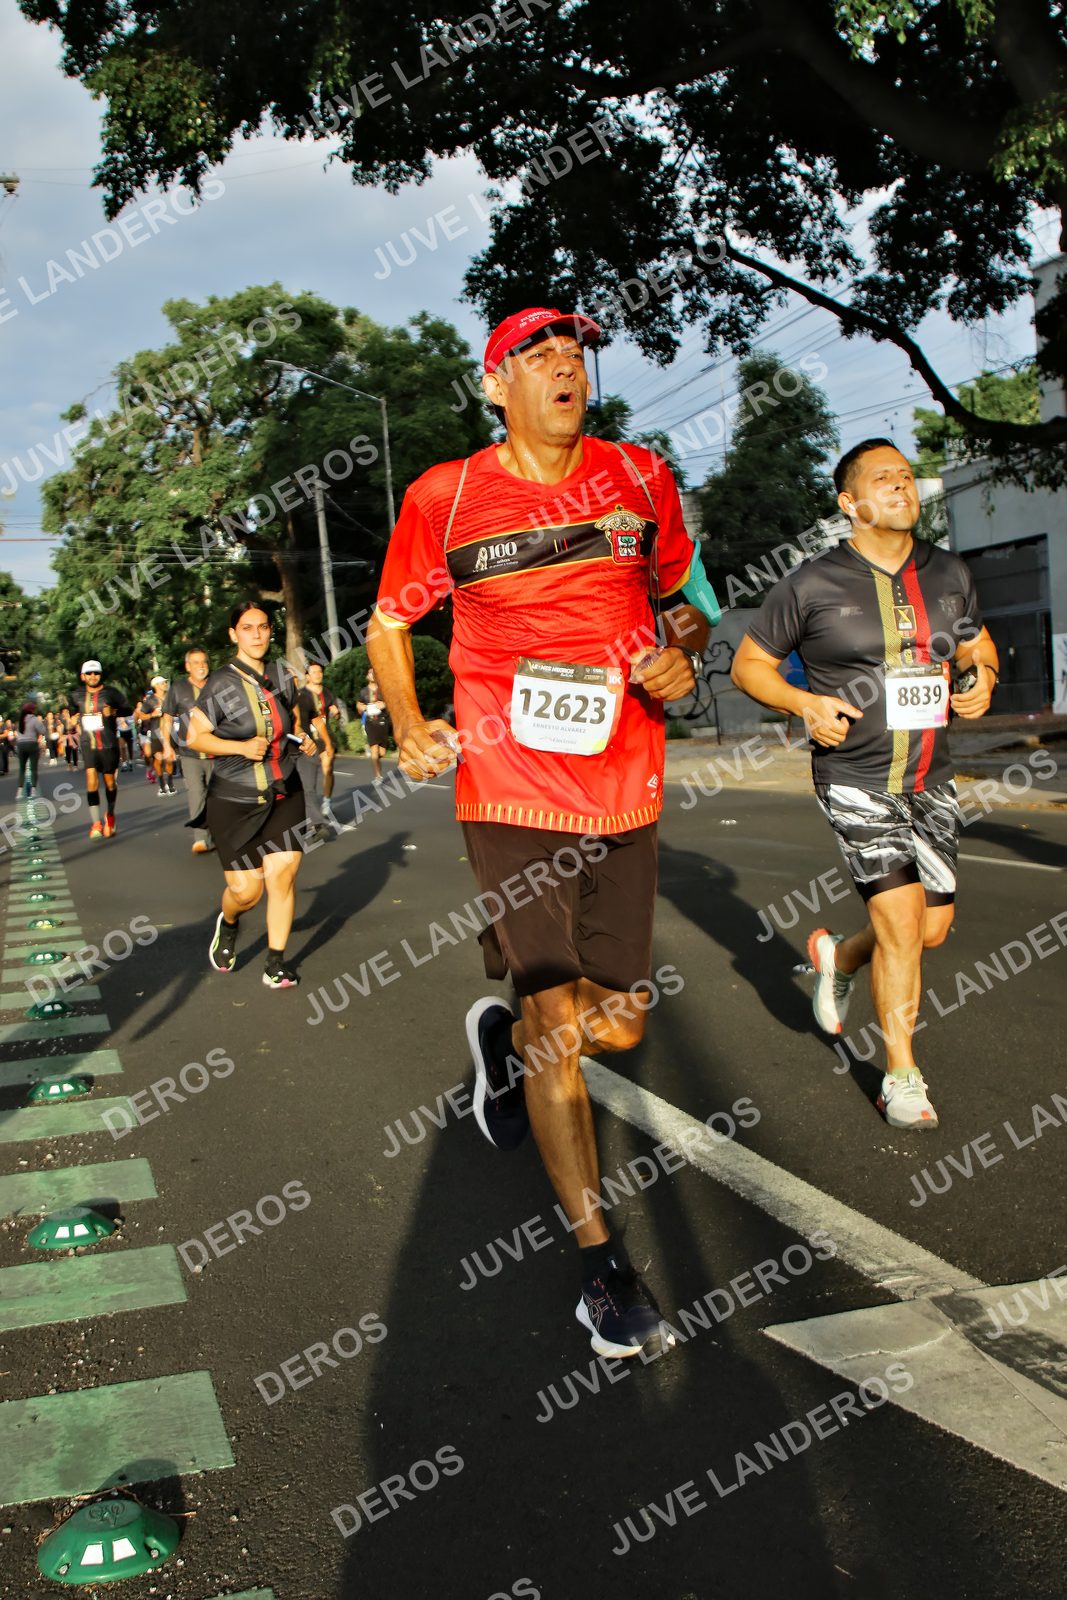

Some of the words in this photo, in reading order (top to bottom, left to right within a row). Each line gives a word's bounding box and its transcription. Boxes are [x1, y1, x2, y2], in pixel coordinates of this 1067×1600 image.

[488, 541, 518, 560] 100
[897, 685, 942, 706] 8839
[519, 688, 607, 725] 12623
